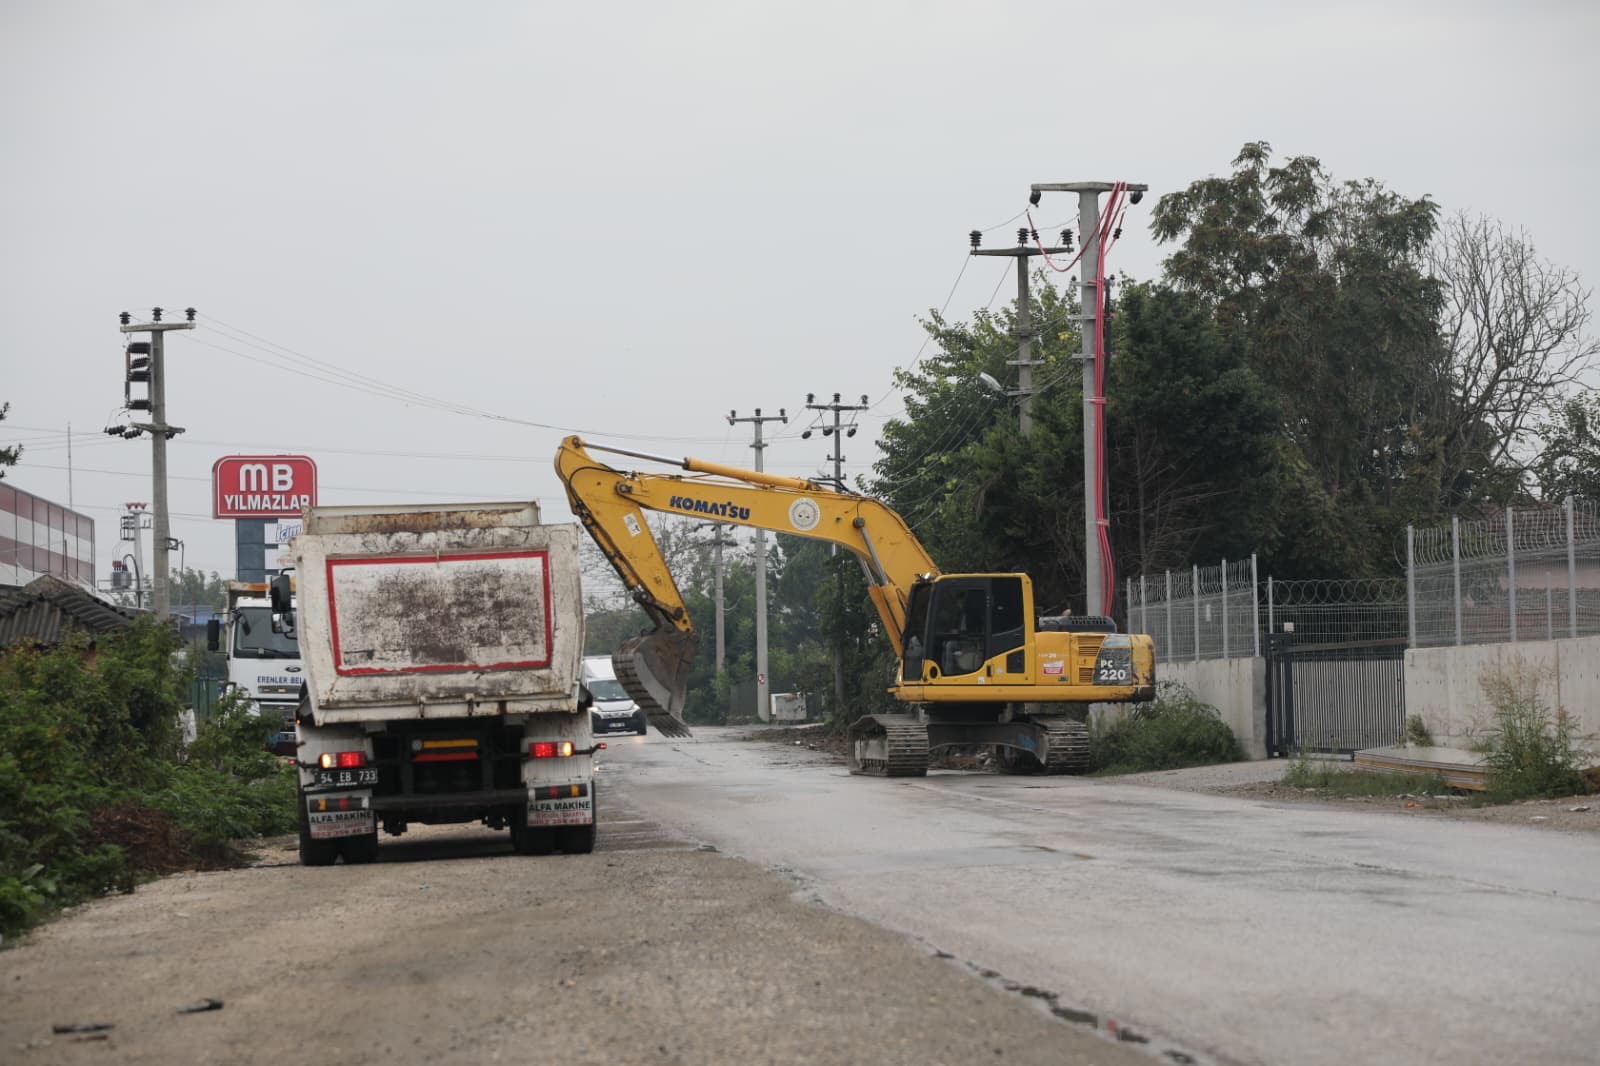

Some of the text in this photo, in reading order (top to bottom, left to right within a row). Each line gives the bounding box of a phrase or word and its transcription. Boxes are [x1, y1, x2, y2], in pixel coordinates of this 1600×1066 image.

[224, 494, 310, 511] YILMAZLAR
[669, 495, 750, 520] KOMATSU
[1100, 660, 1113, 668] PC
[257, 675, 288, 684] ERENLER
[1100, 669, 1126, 681] 220
[321, 770, 376, 784] 54 EB 733
[528, 802, 552, 812] ALFA
[311, 815, 334, 824] ALFA
